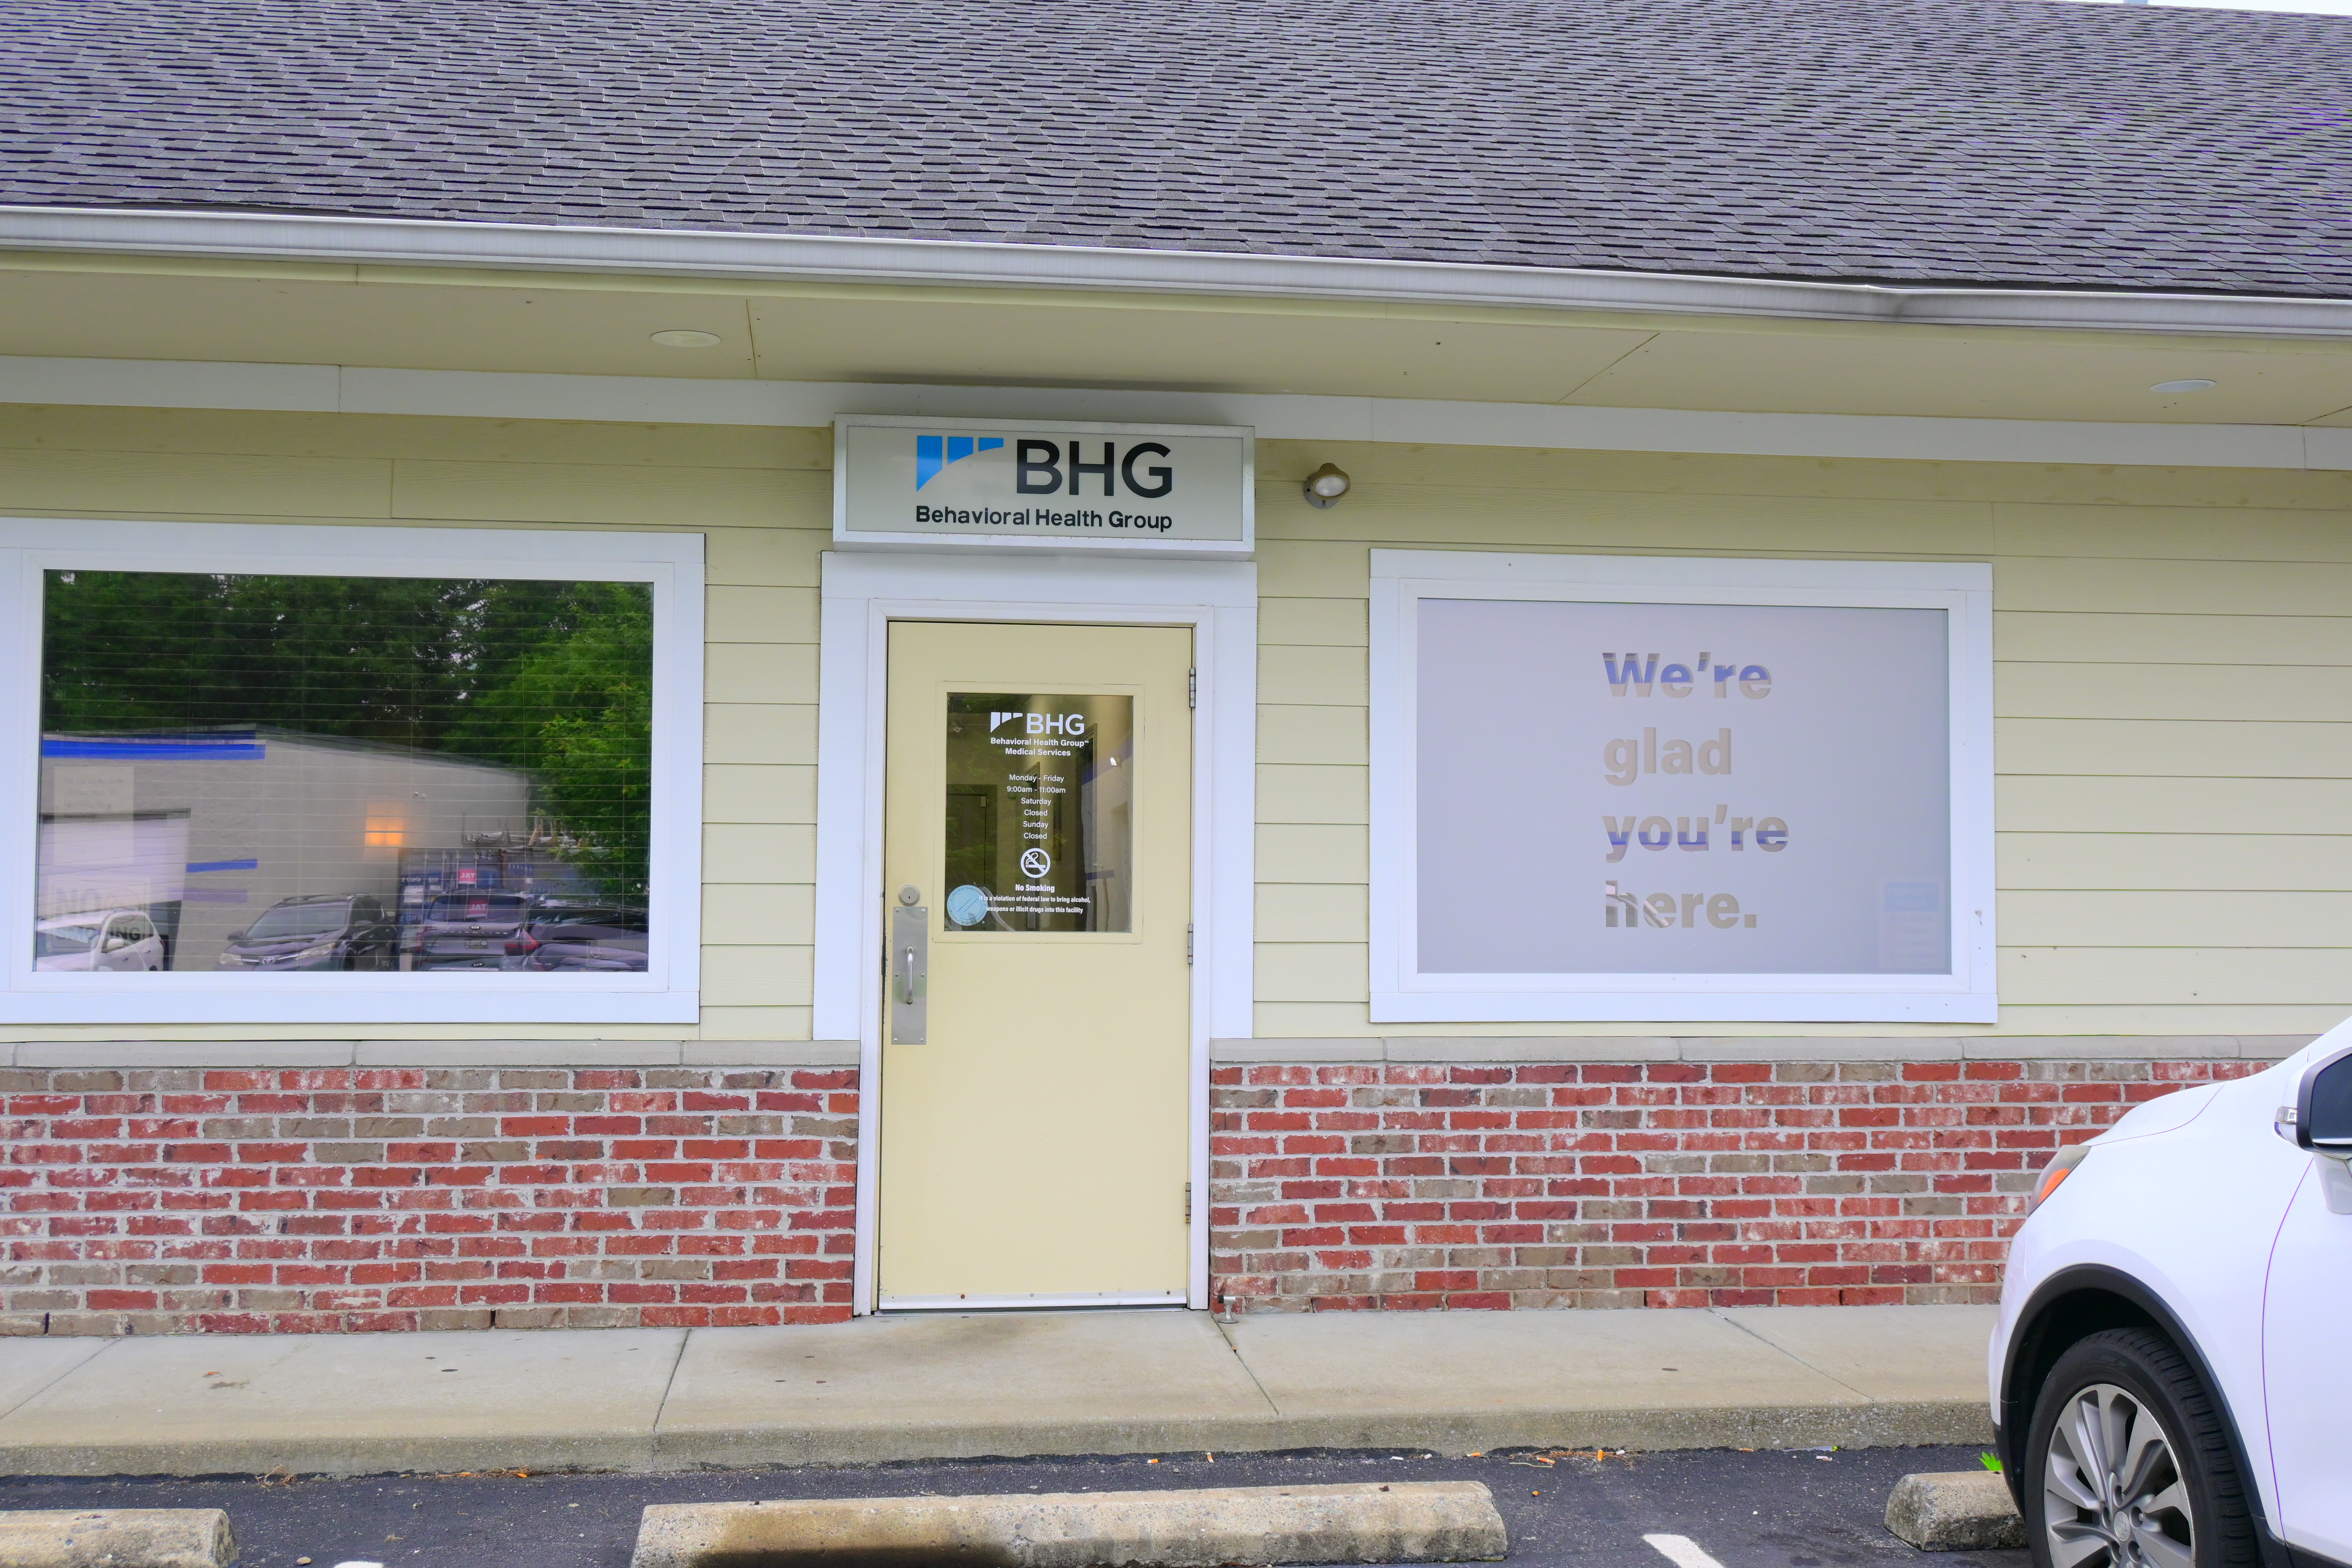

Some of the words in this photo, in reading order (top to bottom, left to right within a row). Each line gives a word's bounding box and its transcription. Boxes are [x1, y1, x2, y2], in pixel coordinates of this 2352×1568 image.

[1016, 439, 1173, 498] BHG
[916, 505, 1030, 526] Behavioral
[1035, 509, 1102, 528] Health
[1108, 511, 1173, 533] Group
[1602, 651, 1772, 700] We're
[1026, 713, 1085, 735] BHG
[990, 737, 1032, 745] Behavioral
[1604, 727, 1732, 787] glad
[1009, 774, 1037, 782] Monday
[1043, 775, 1064, 783] Friday
[1021, 798, 1051, 806] Saturday
[1023, 820, 1049, 829] Sunday
[1602, 803, 1790, 863] you're
[1025, 884, 1055, 893] Smoking
[1605, 879, 1758, 929] here.
